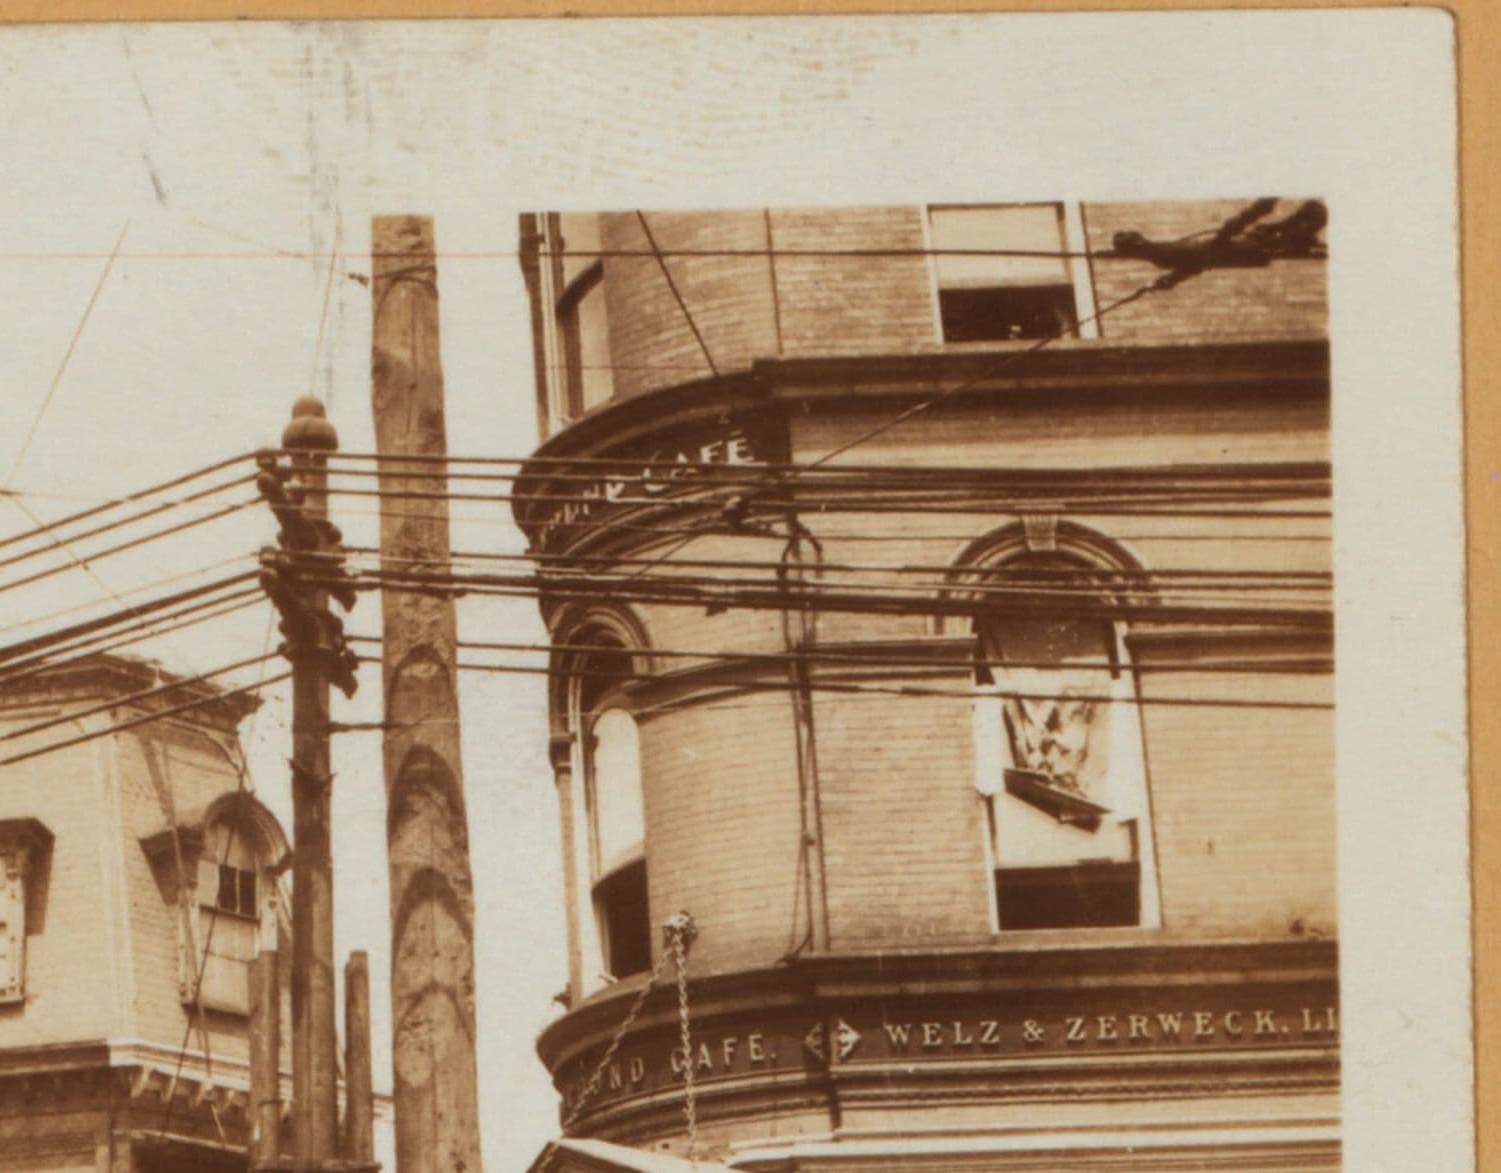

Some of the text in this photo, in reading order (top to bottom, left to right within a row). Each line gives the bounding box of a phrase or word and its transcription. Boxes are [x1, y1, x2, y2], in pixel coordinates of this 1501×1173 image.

[883, 1021, 1001, 1047] WELZ
[1022, 1020, 1045, 1042] &
[1065, 1010, 1290, 1041] ZERWECK.
